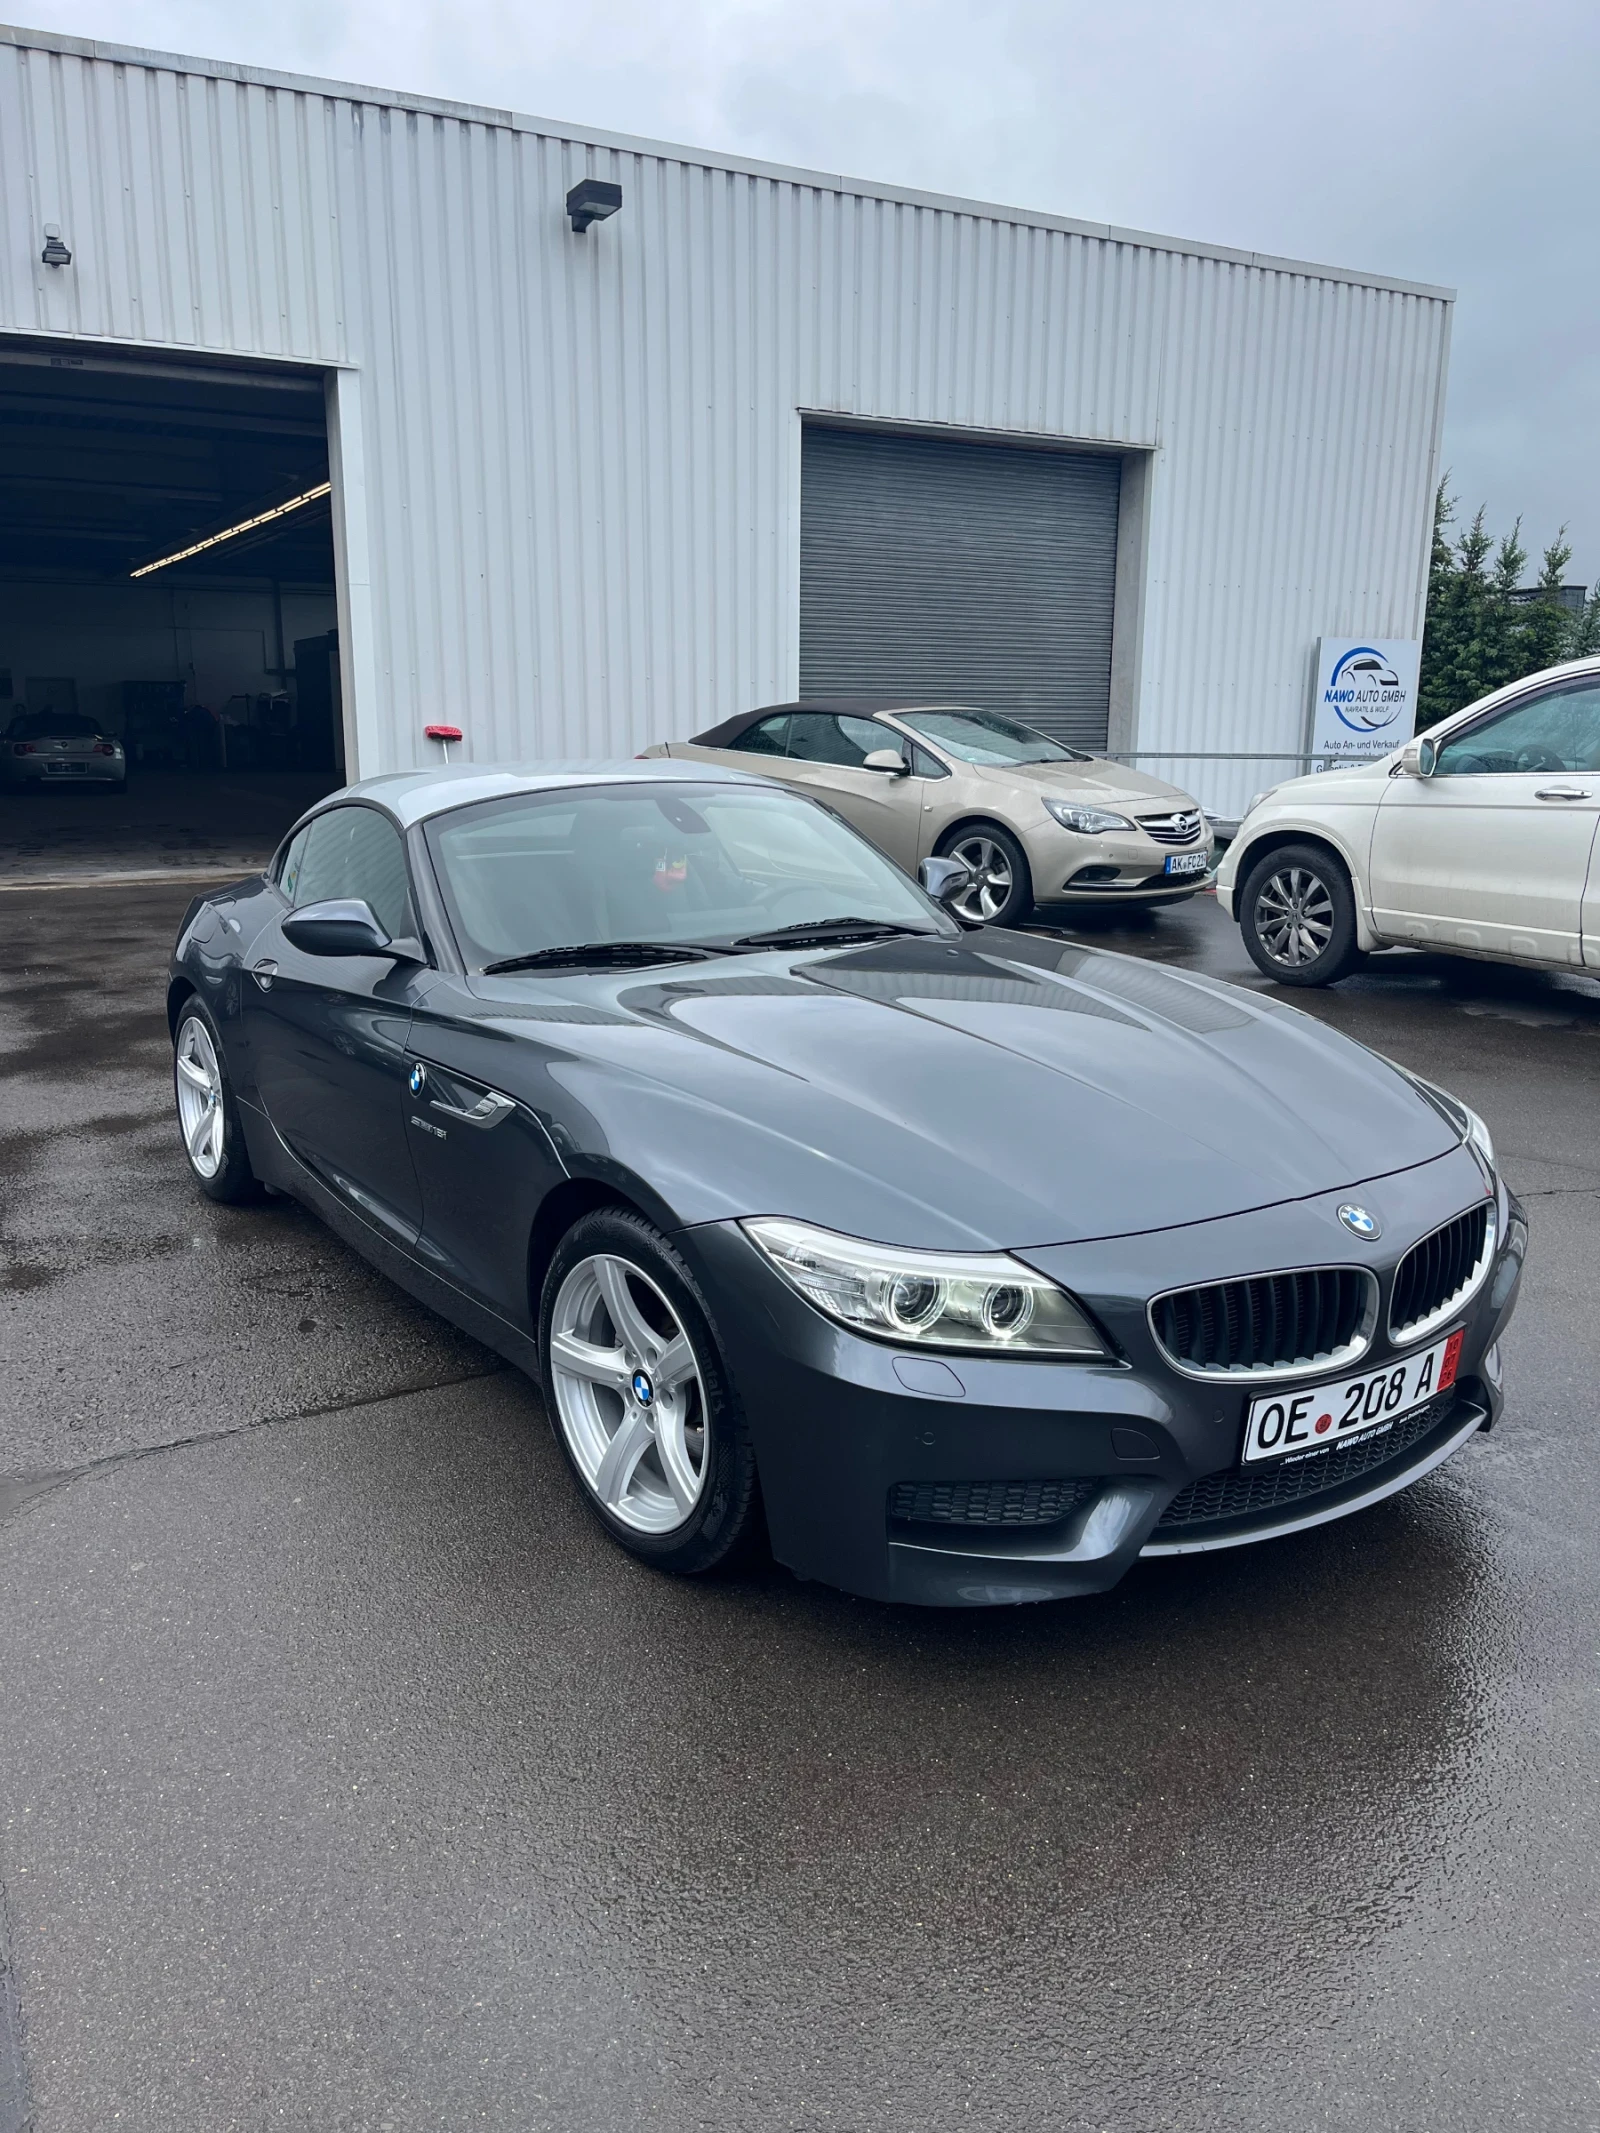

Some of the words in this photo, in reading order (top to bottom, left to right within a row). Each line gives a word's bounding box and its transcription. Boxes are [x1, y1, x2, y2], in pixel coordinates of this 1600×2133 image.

[1324, 690, 1355, 702] NAWO
[1355, 690, 1379, 702] AUTO
[1381, 690, 1406, 702] GMBH
[1323, 740, 1341, 749] Auto
[1343, 740, 1355, 749] An-
[1357, 740, 1370, 749] und
[1372, 739, 1400, 749] Verkauf
[1257, 1395, 1315, 1449] OE
[1338, 1366, 1406, 1430] 208
[1413, 1352, 1435, 1400] A
[1358, 1428, 1377, 1443] AUTO
